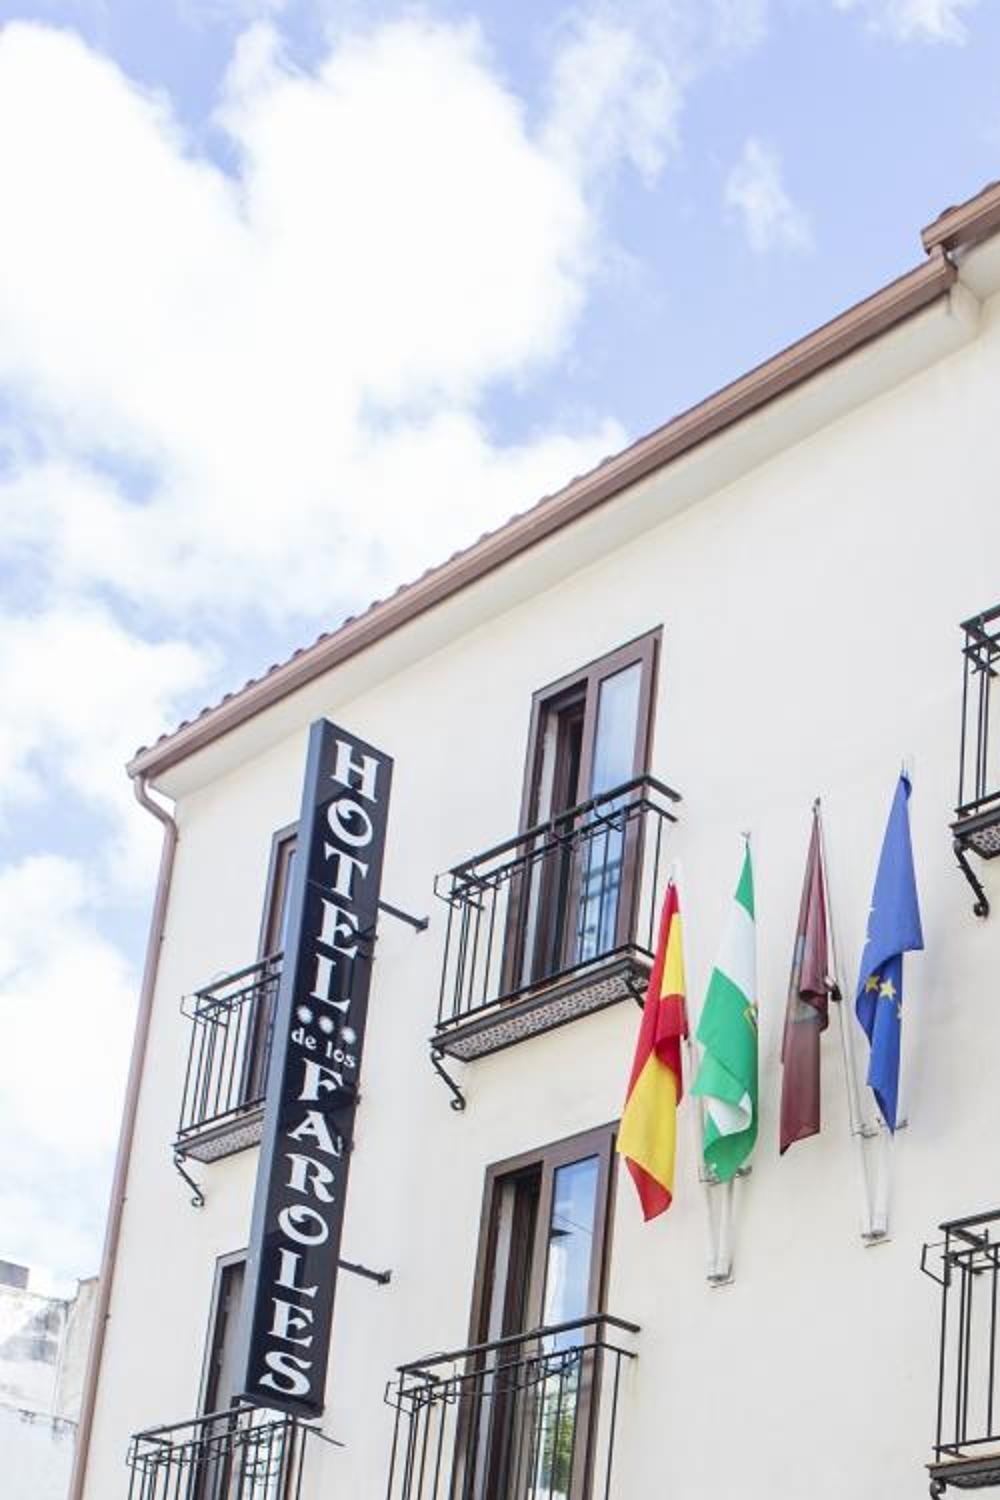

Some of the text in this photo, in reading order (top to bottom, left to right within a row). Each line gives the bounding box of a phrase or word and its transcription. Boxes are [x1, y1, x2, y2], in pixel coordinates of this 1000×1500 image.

[310, 739, 381, 1013] HOTEL
[291, 1026, 356, 1068] de los
[258, 1057, 344, 1396] FAROLES
